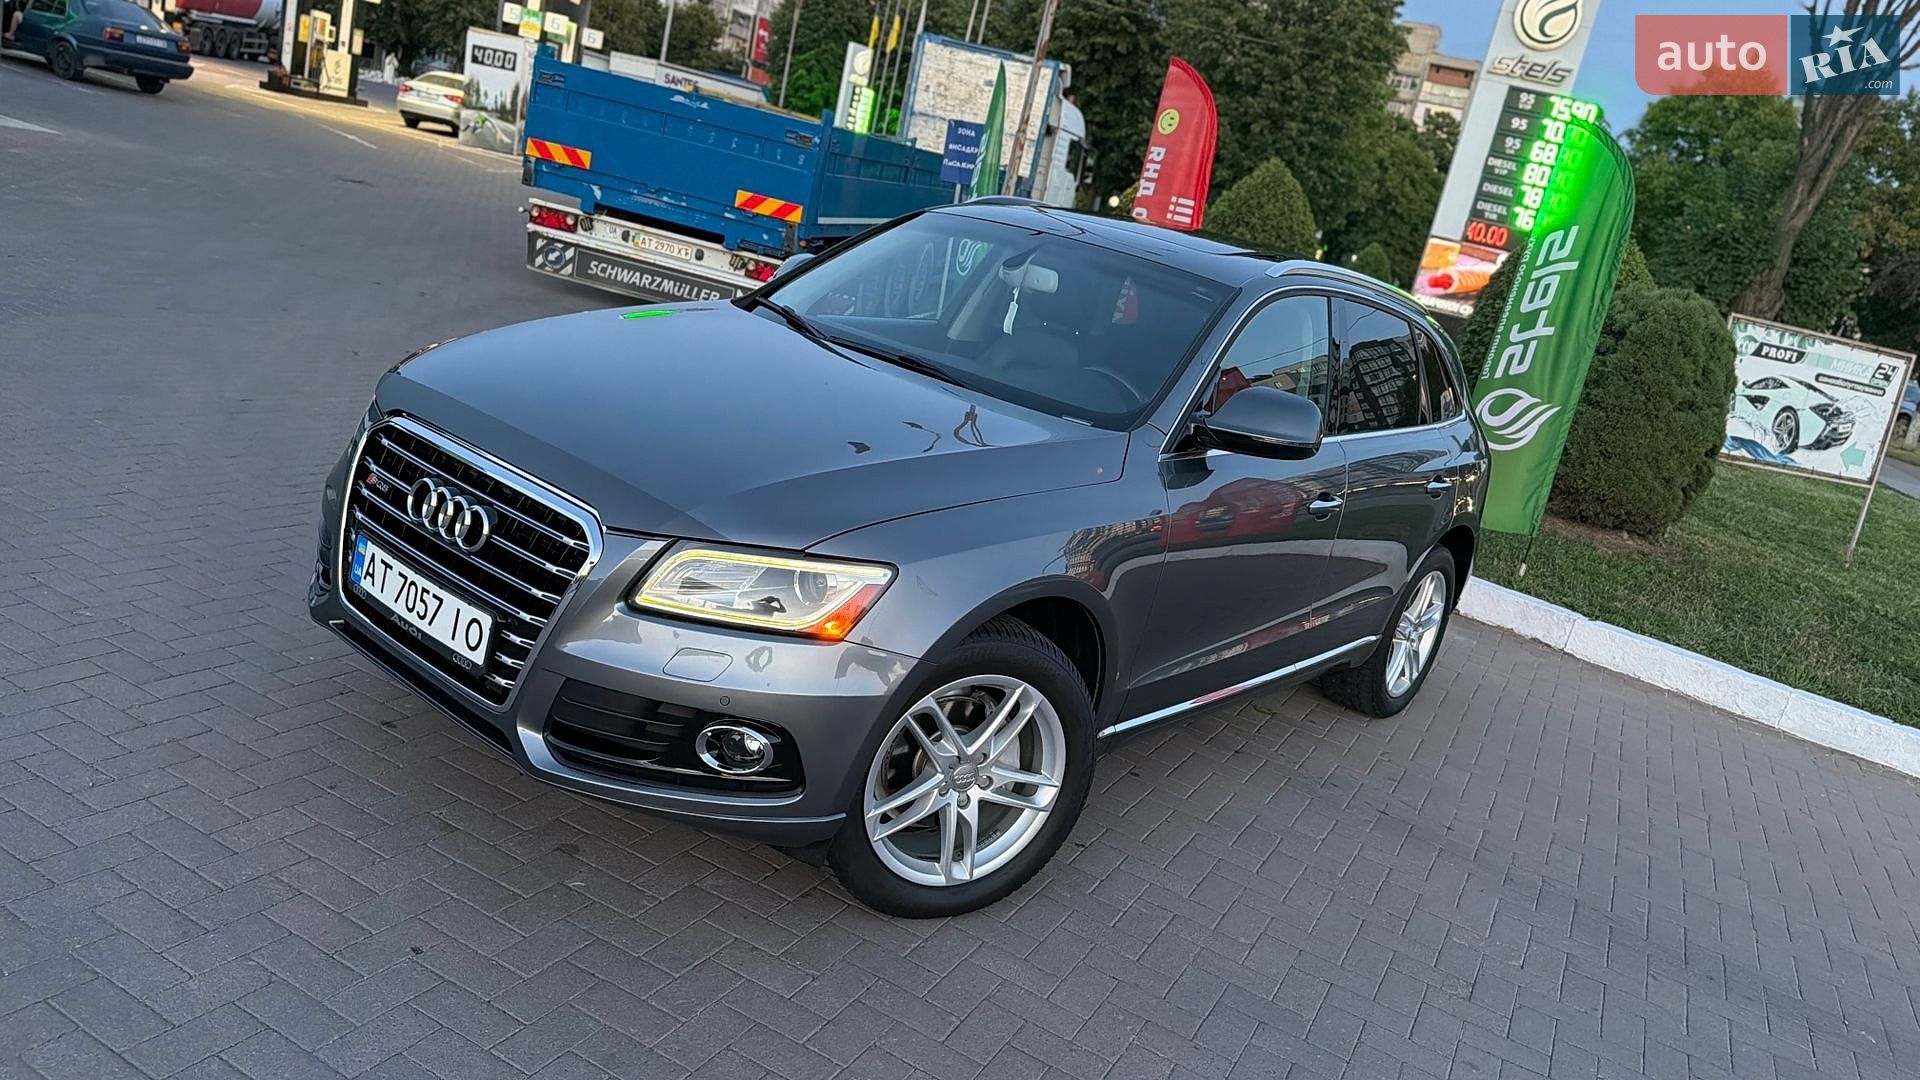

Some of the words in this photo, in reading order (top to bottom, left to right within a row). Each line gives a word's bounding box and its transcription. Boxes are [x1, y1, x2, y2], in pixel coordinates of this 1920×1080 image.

[551, 18, 561, 31] 6
[587, 32, 597, 44] 6
[1489, 54, 1573, 86] stels
[1519, 92, 1536, 104] 95
[1511, 117, 1528, 130] 95
[957, 127, 976, 137] ЗОНА
[1504, 137, 1522, 150] 95
[1487, 157, 1517, 171] DIESEL
[1494, 168, 1509, 176] VIP
[1482, 183, 1514, 197] DIESEL
[1477, 201, 1508, 215] DIESEL
[640, 237, 653, 249] AT
[654, 239, 675, 255] 2970
[1761, 345, 1798, 362] PROFI
[1876, 363, 1898, 382] 24
[354, 564, 362, 576] UA
[363, 553, 393, 594] AT
[394, 571, 444, 626] 7057
[451, 608, 483, 652] IO
